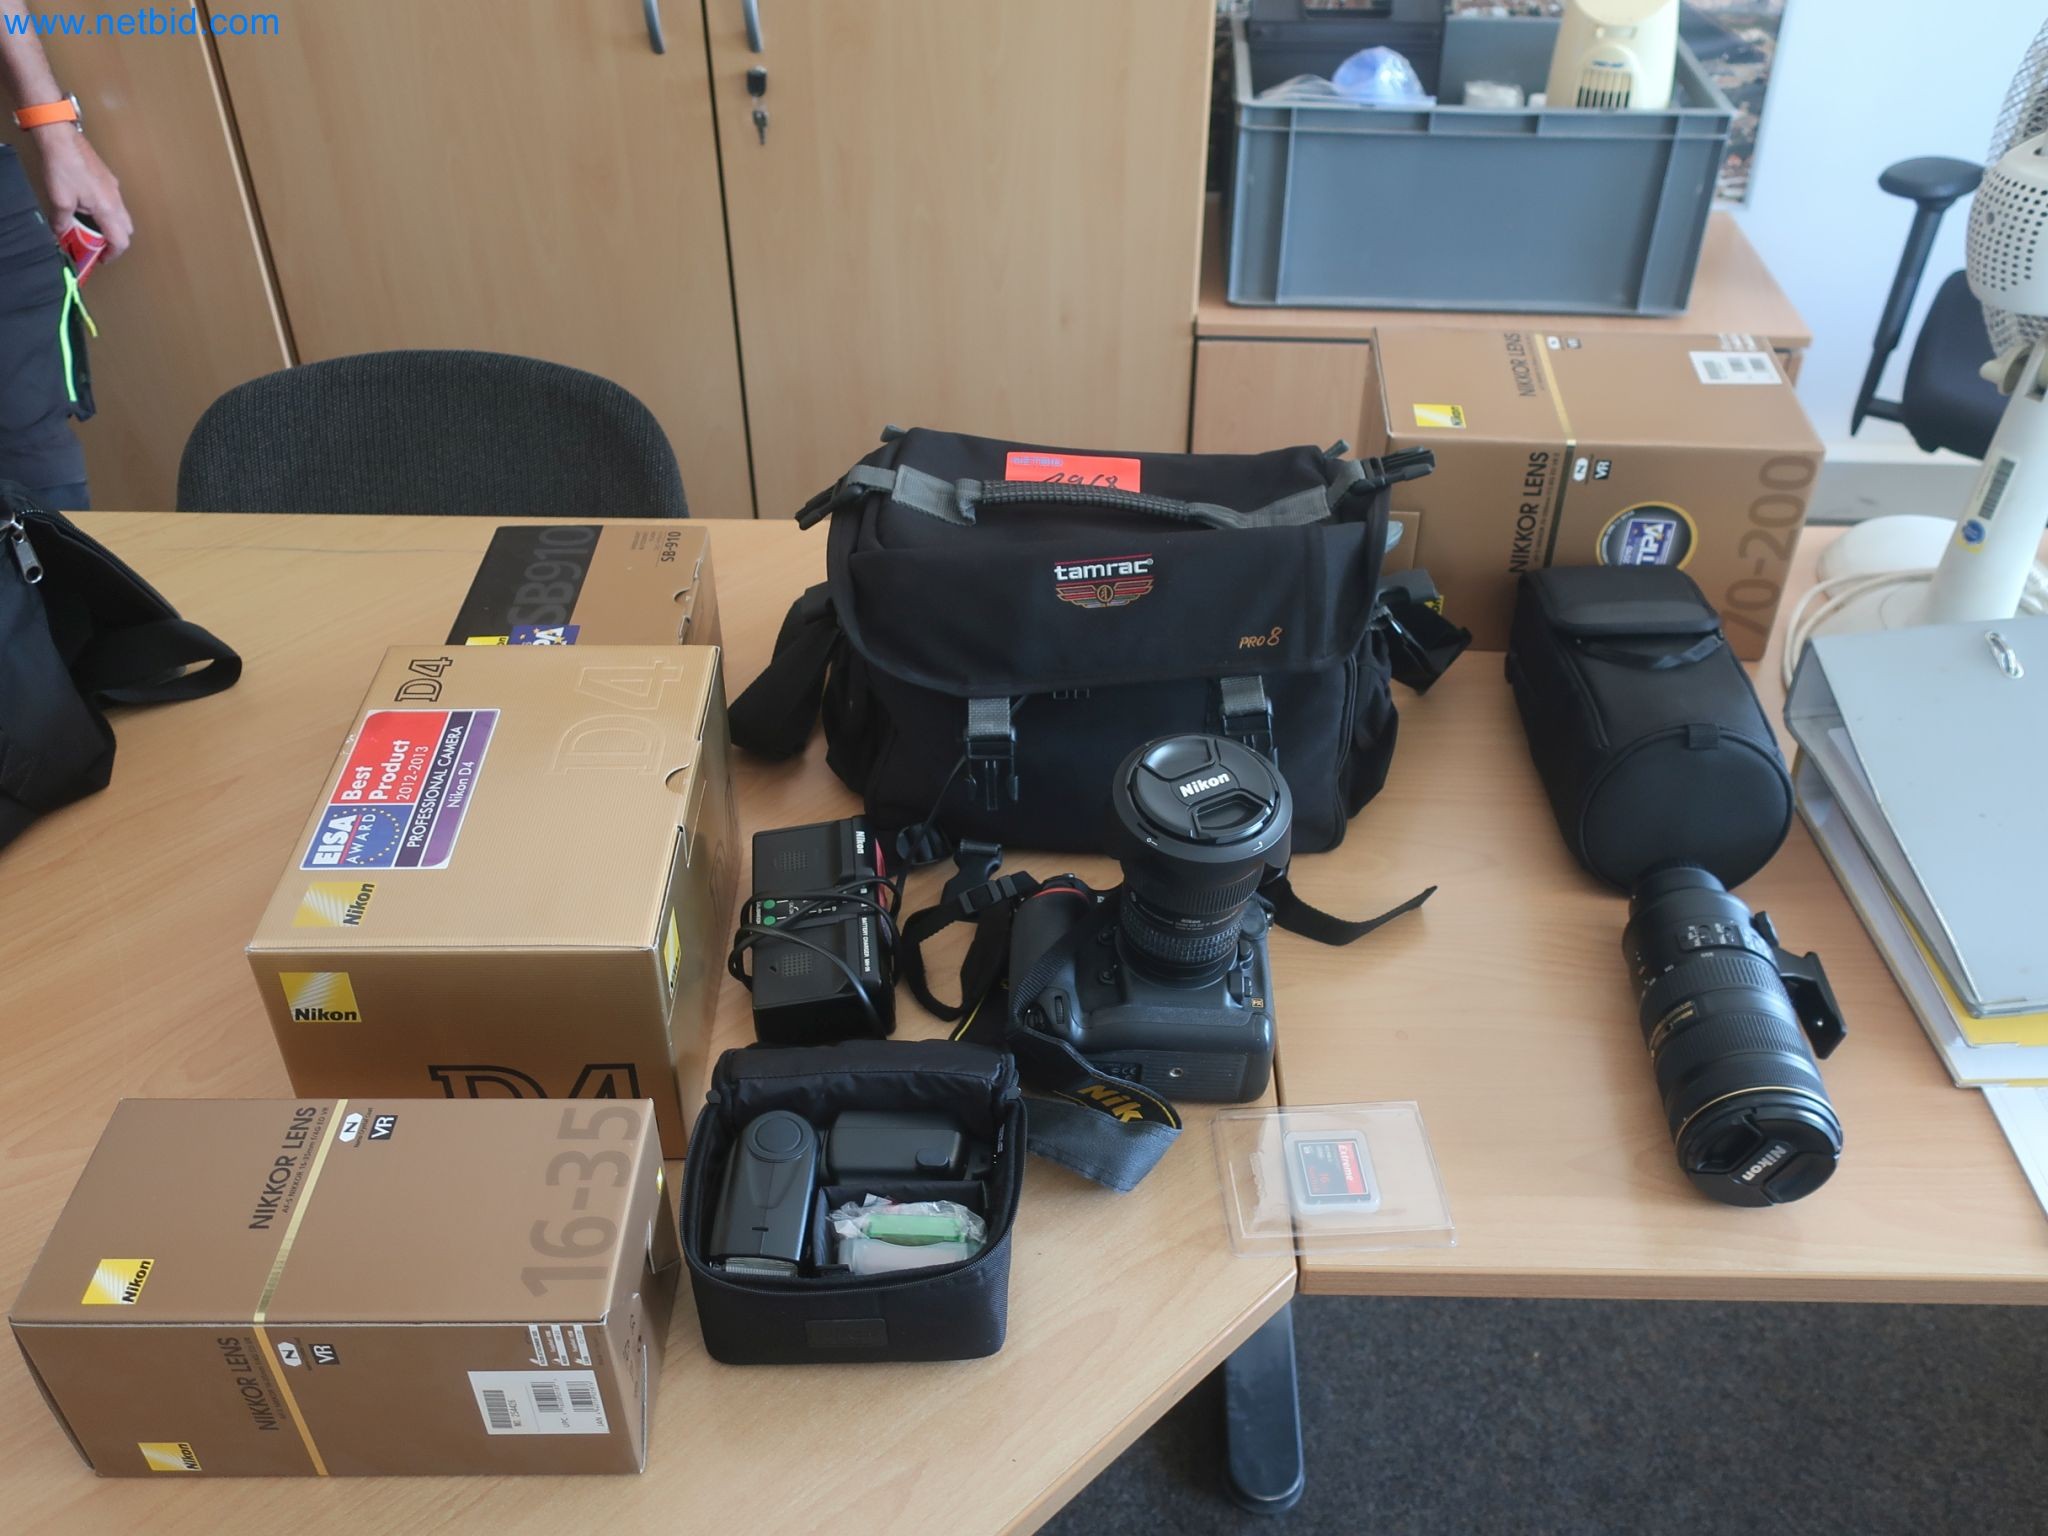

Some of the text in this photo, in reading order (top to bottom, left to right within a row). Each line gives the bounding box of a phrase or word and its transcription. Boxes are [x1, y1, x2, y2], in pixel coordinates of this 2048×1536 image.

[1523, 451, 1549, 496] LENS
[661, 532, 681, 562] SB-910
[1509, 503, 1539, 573] NIKKOR
[507, 527, 596, 626] SB910
[1054, 558, 1149, 581] tamrac
[1240, 635, 1264, 649] PRO
[394, 656, 453, 702] D4
[341, 766, 373, 800] Best
[368, 739, 411, 800] Product
[396, 746, 429, 800] 2012-2013
[407, 726, 463, 847] PROFESSIONAL CAMERA
[447, 761, 475, 808] Nikon D4
[1179, 771, 1230, 798] Nikon
[312, 815, 357, 864] EISA
[347, 814, 376, 864] AWARD
[856, 830, 866, 854] Nikon
[343, 883, 375, 926] Nikon
[295, 1008, 358, 1022] Nikon
[371, 1116, 395, 1138] VR
[249, 1106, 317, 1230] NIKKOR LENS
[1338, 1144, 1353, 1181] Extreme
[1742, 1145, 1787, 1181] Nikon
[520, 1106, 641, 1297] 16-35
[121, 1260, 151, 1303] Nikon
[217, 1337, 249, 1374] LENS
[312, 1344, 336, 1364] VR
[236, 1377, 279, 1431] NIKKOR
[178, 1443, 197, 1470] Nikon
